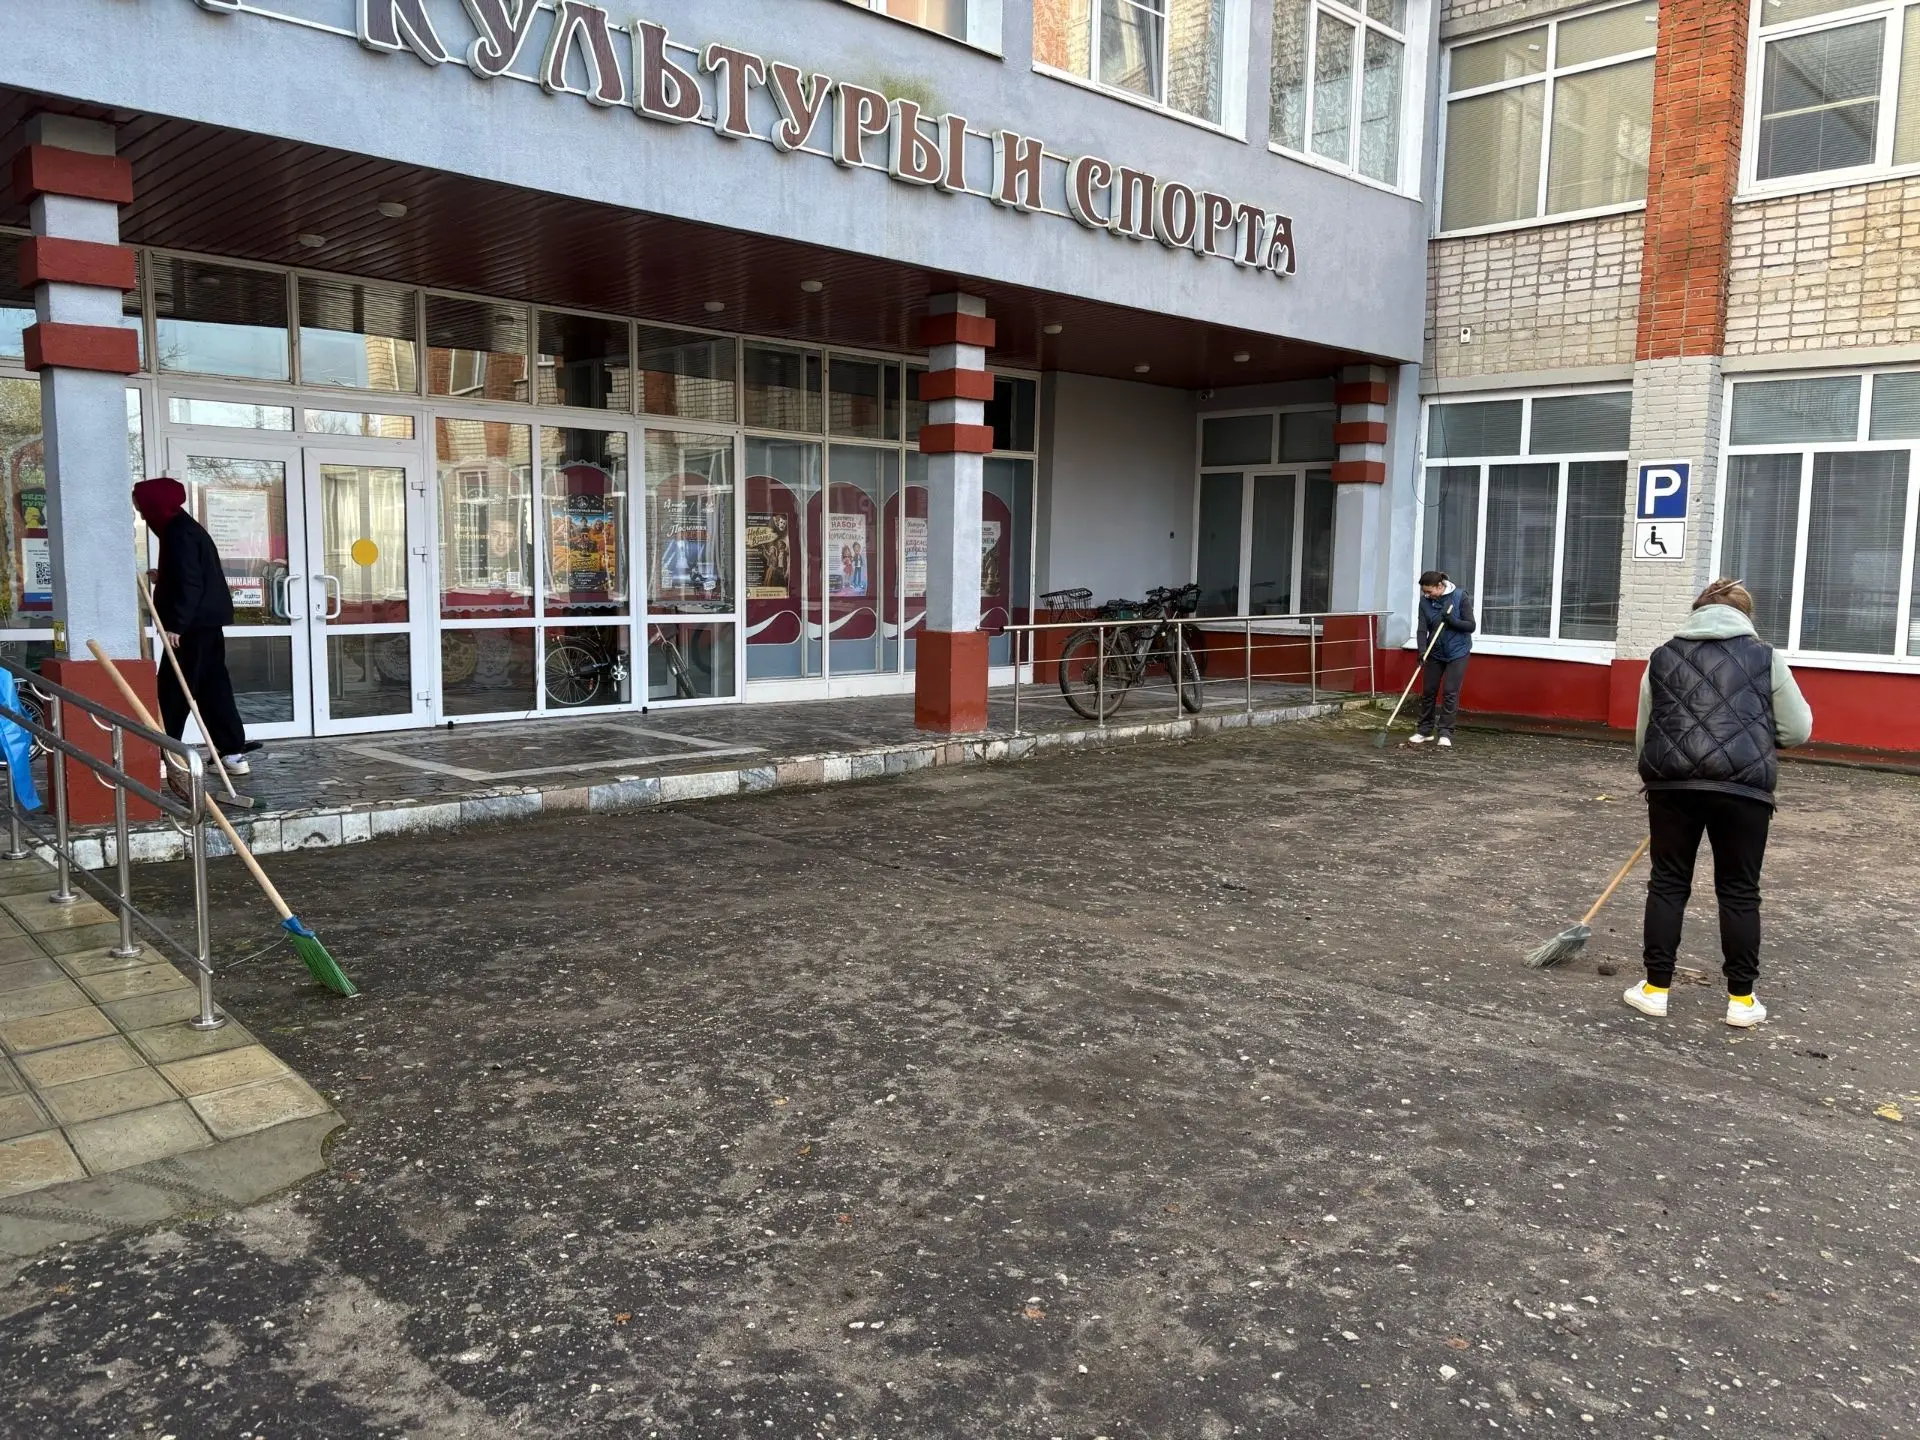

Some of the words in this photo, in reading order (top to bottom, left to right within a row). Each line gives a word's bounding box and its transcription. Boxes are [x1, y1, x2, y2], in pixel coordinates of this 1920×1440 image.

[991, 129, 1044, 214] И
[1066, 154, 1297, 278] СПОРТА
[1644, 469, 1682, 515] P
[831, 521, 856, 529] НАБОР
[225, 576, 260, 587] НИМАНИЕ
